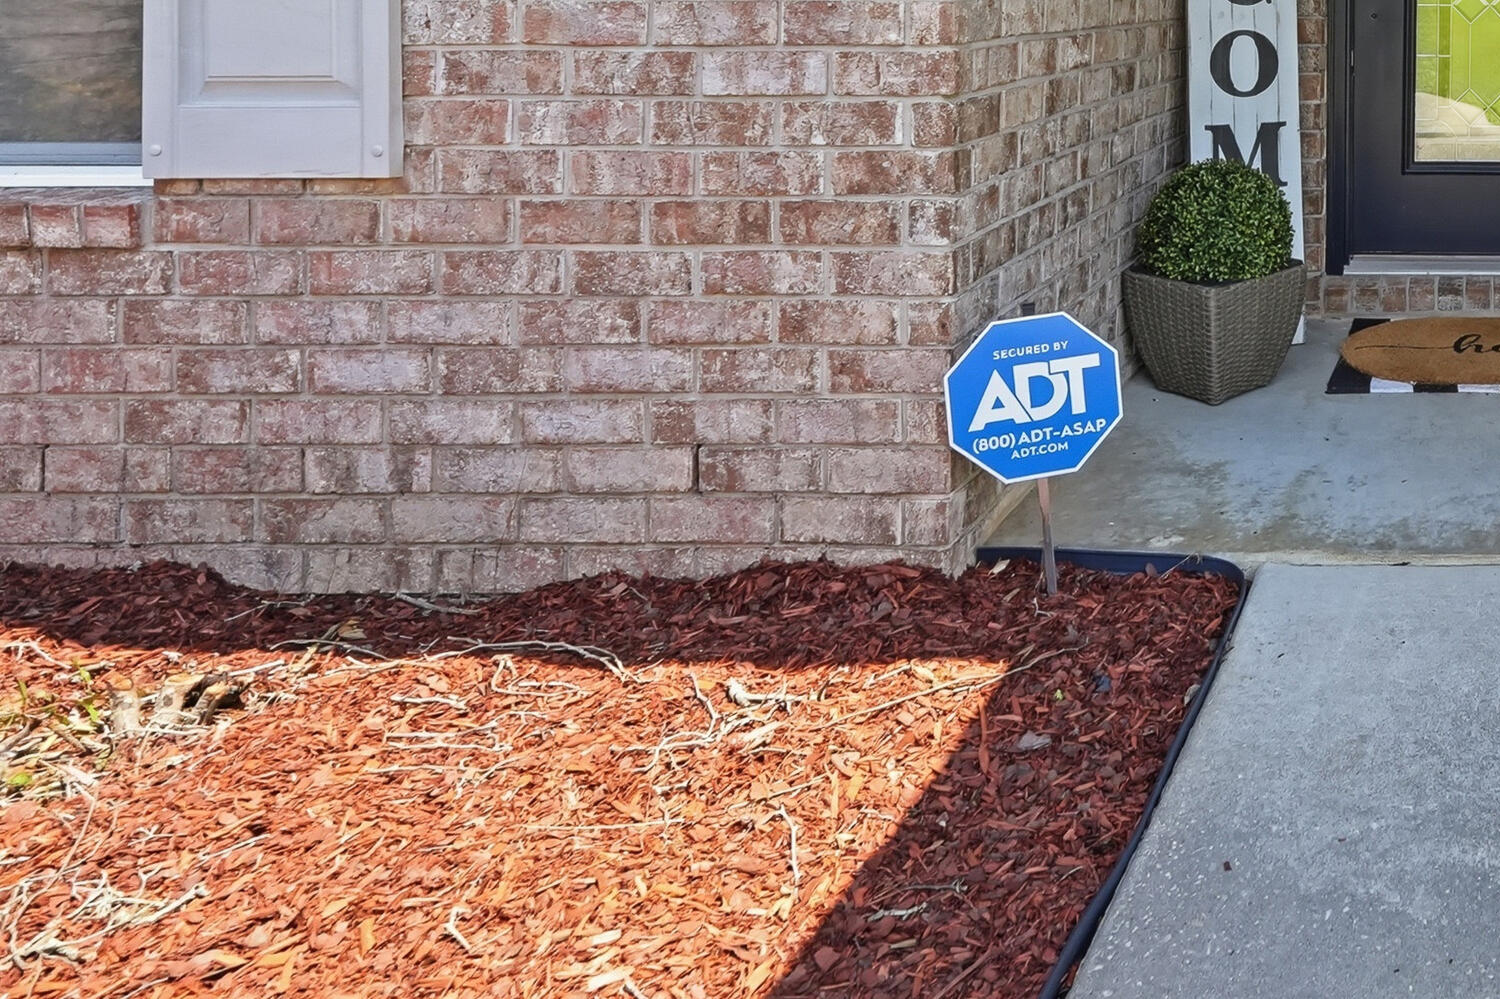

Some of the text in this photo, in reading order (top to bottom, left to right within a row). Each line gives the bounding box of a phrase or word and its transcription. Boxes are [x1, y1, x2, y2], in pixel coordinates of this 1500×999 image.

[993, 341, 1069, 360] SECURED BY
[968, 352, 1100, 432] ADT
[972, 419, 1107, 454] (800) ADT-ASAP
[1011, 442, 1069, 460] ADT.COM
